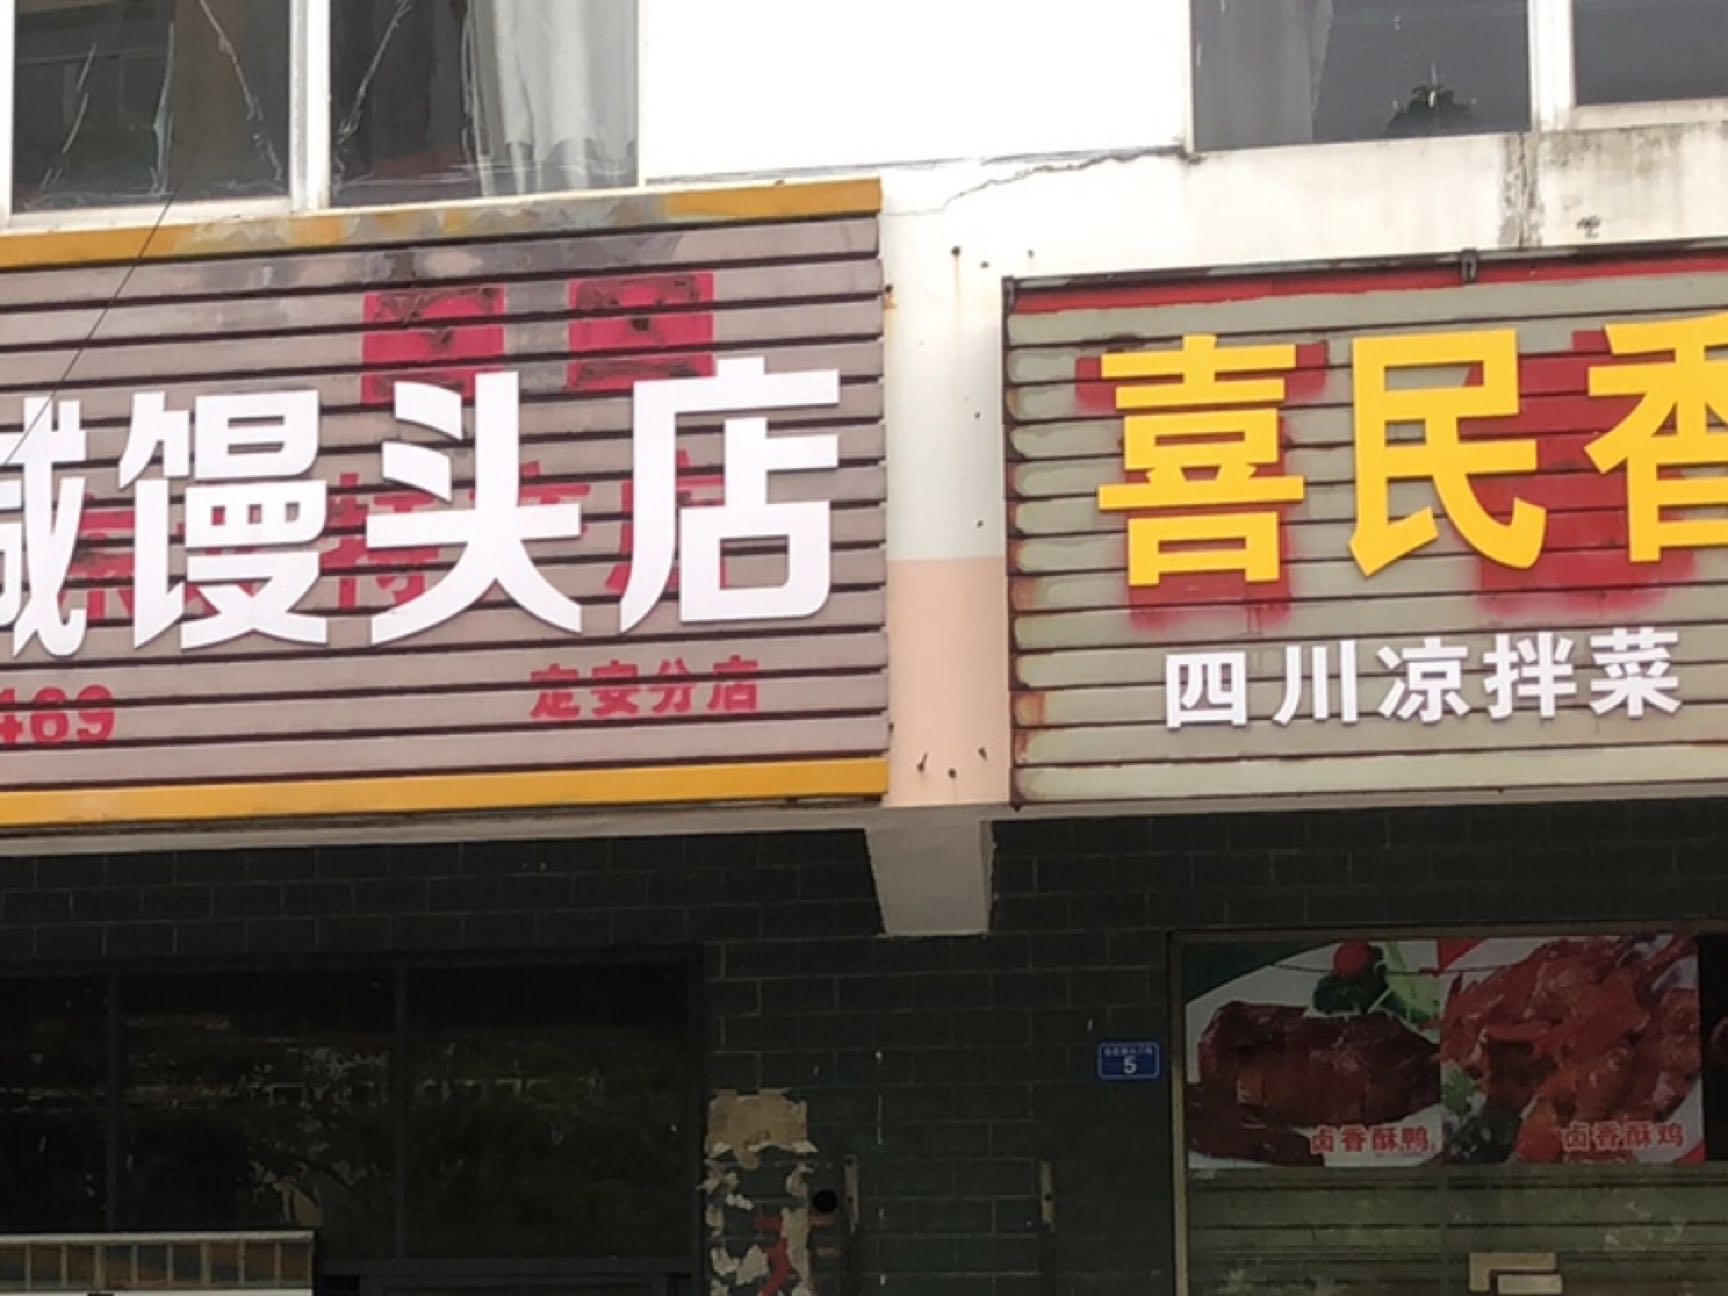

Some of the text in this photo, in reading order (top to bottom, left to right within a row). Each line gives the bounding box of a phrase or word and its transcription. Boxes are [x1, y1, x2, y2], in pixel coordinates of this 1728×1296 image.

[528, 654, 760, 720] 定安分店
[1164, 628, 1682, 728] 四川凉拌菜
